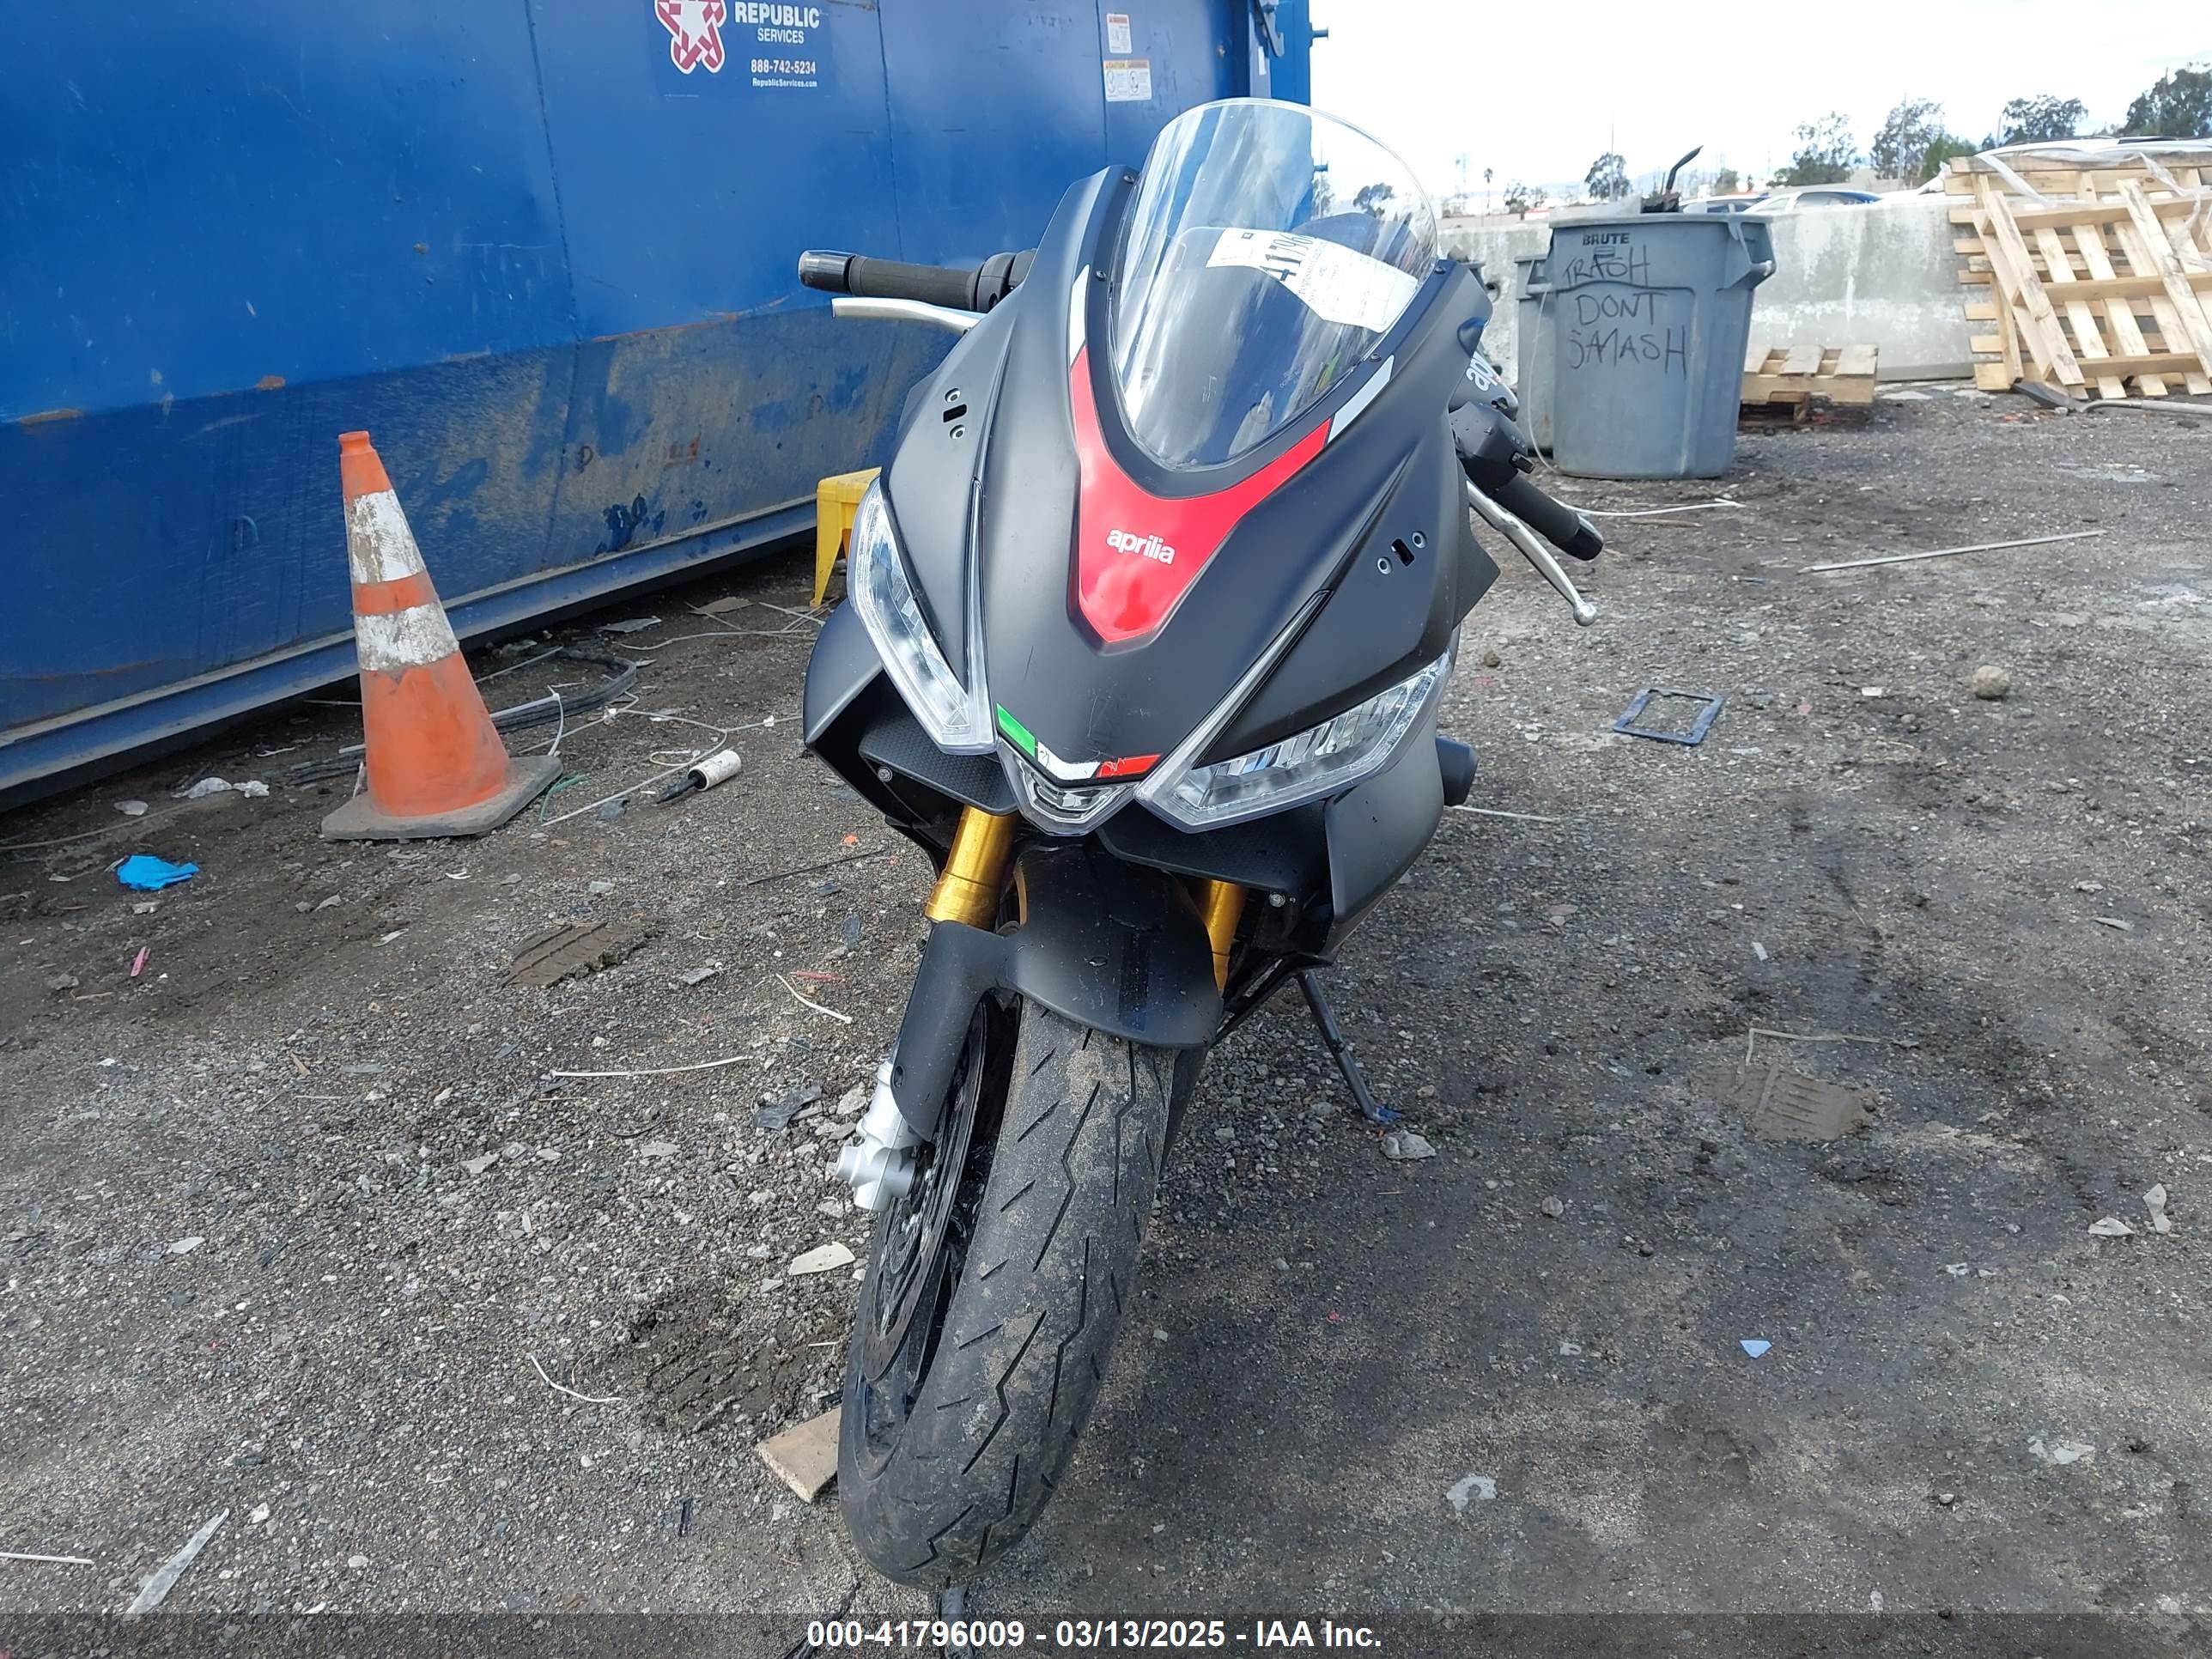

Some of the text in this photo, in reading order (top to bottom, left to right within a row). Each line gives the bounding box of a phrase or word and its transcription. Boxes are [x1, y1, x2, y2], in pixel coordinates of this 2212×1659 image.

[735, 2, 819, 28] REPUBLIC
[757, 27, 805, 44] SERVICES
[750, 58, 816, 75] 888-742-5234
[1583, 233, 1630, 246] BRUTE
[1259, 233, 1316, 282] 41796
[1563, 244, 1650, 289] TRASH
[1576, 291, 1668, 325] DONT
[1566, 325, 1686, 380] SMASH
[1106, 529, 1176, 565] aprilia
